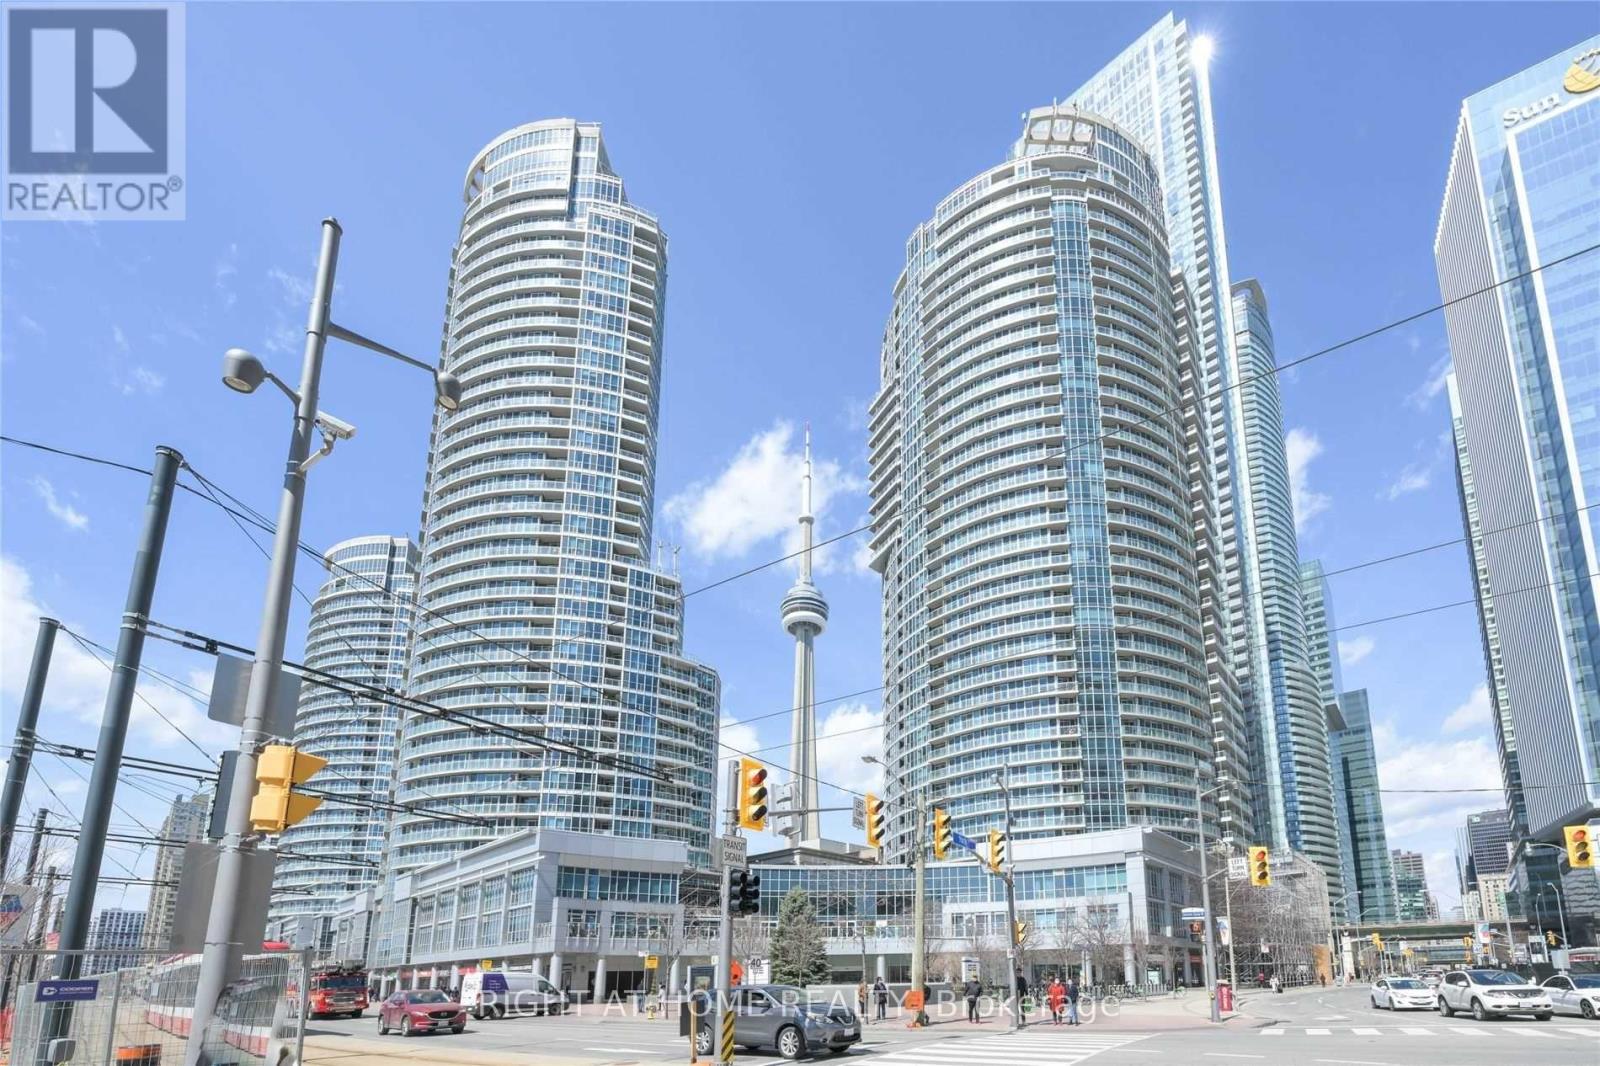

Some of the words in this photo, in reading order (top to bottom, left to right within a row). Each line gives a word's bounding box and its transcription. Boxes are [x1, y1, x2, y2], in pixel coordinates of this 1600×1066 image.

[1503, 92, 1561, 129] Sun
[724, 852, 744, 865] SIGNAL
[750, 958, 762, 967] 40
